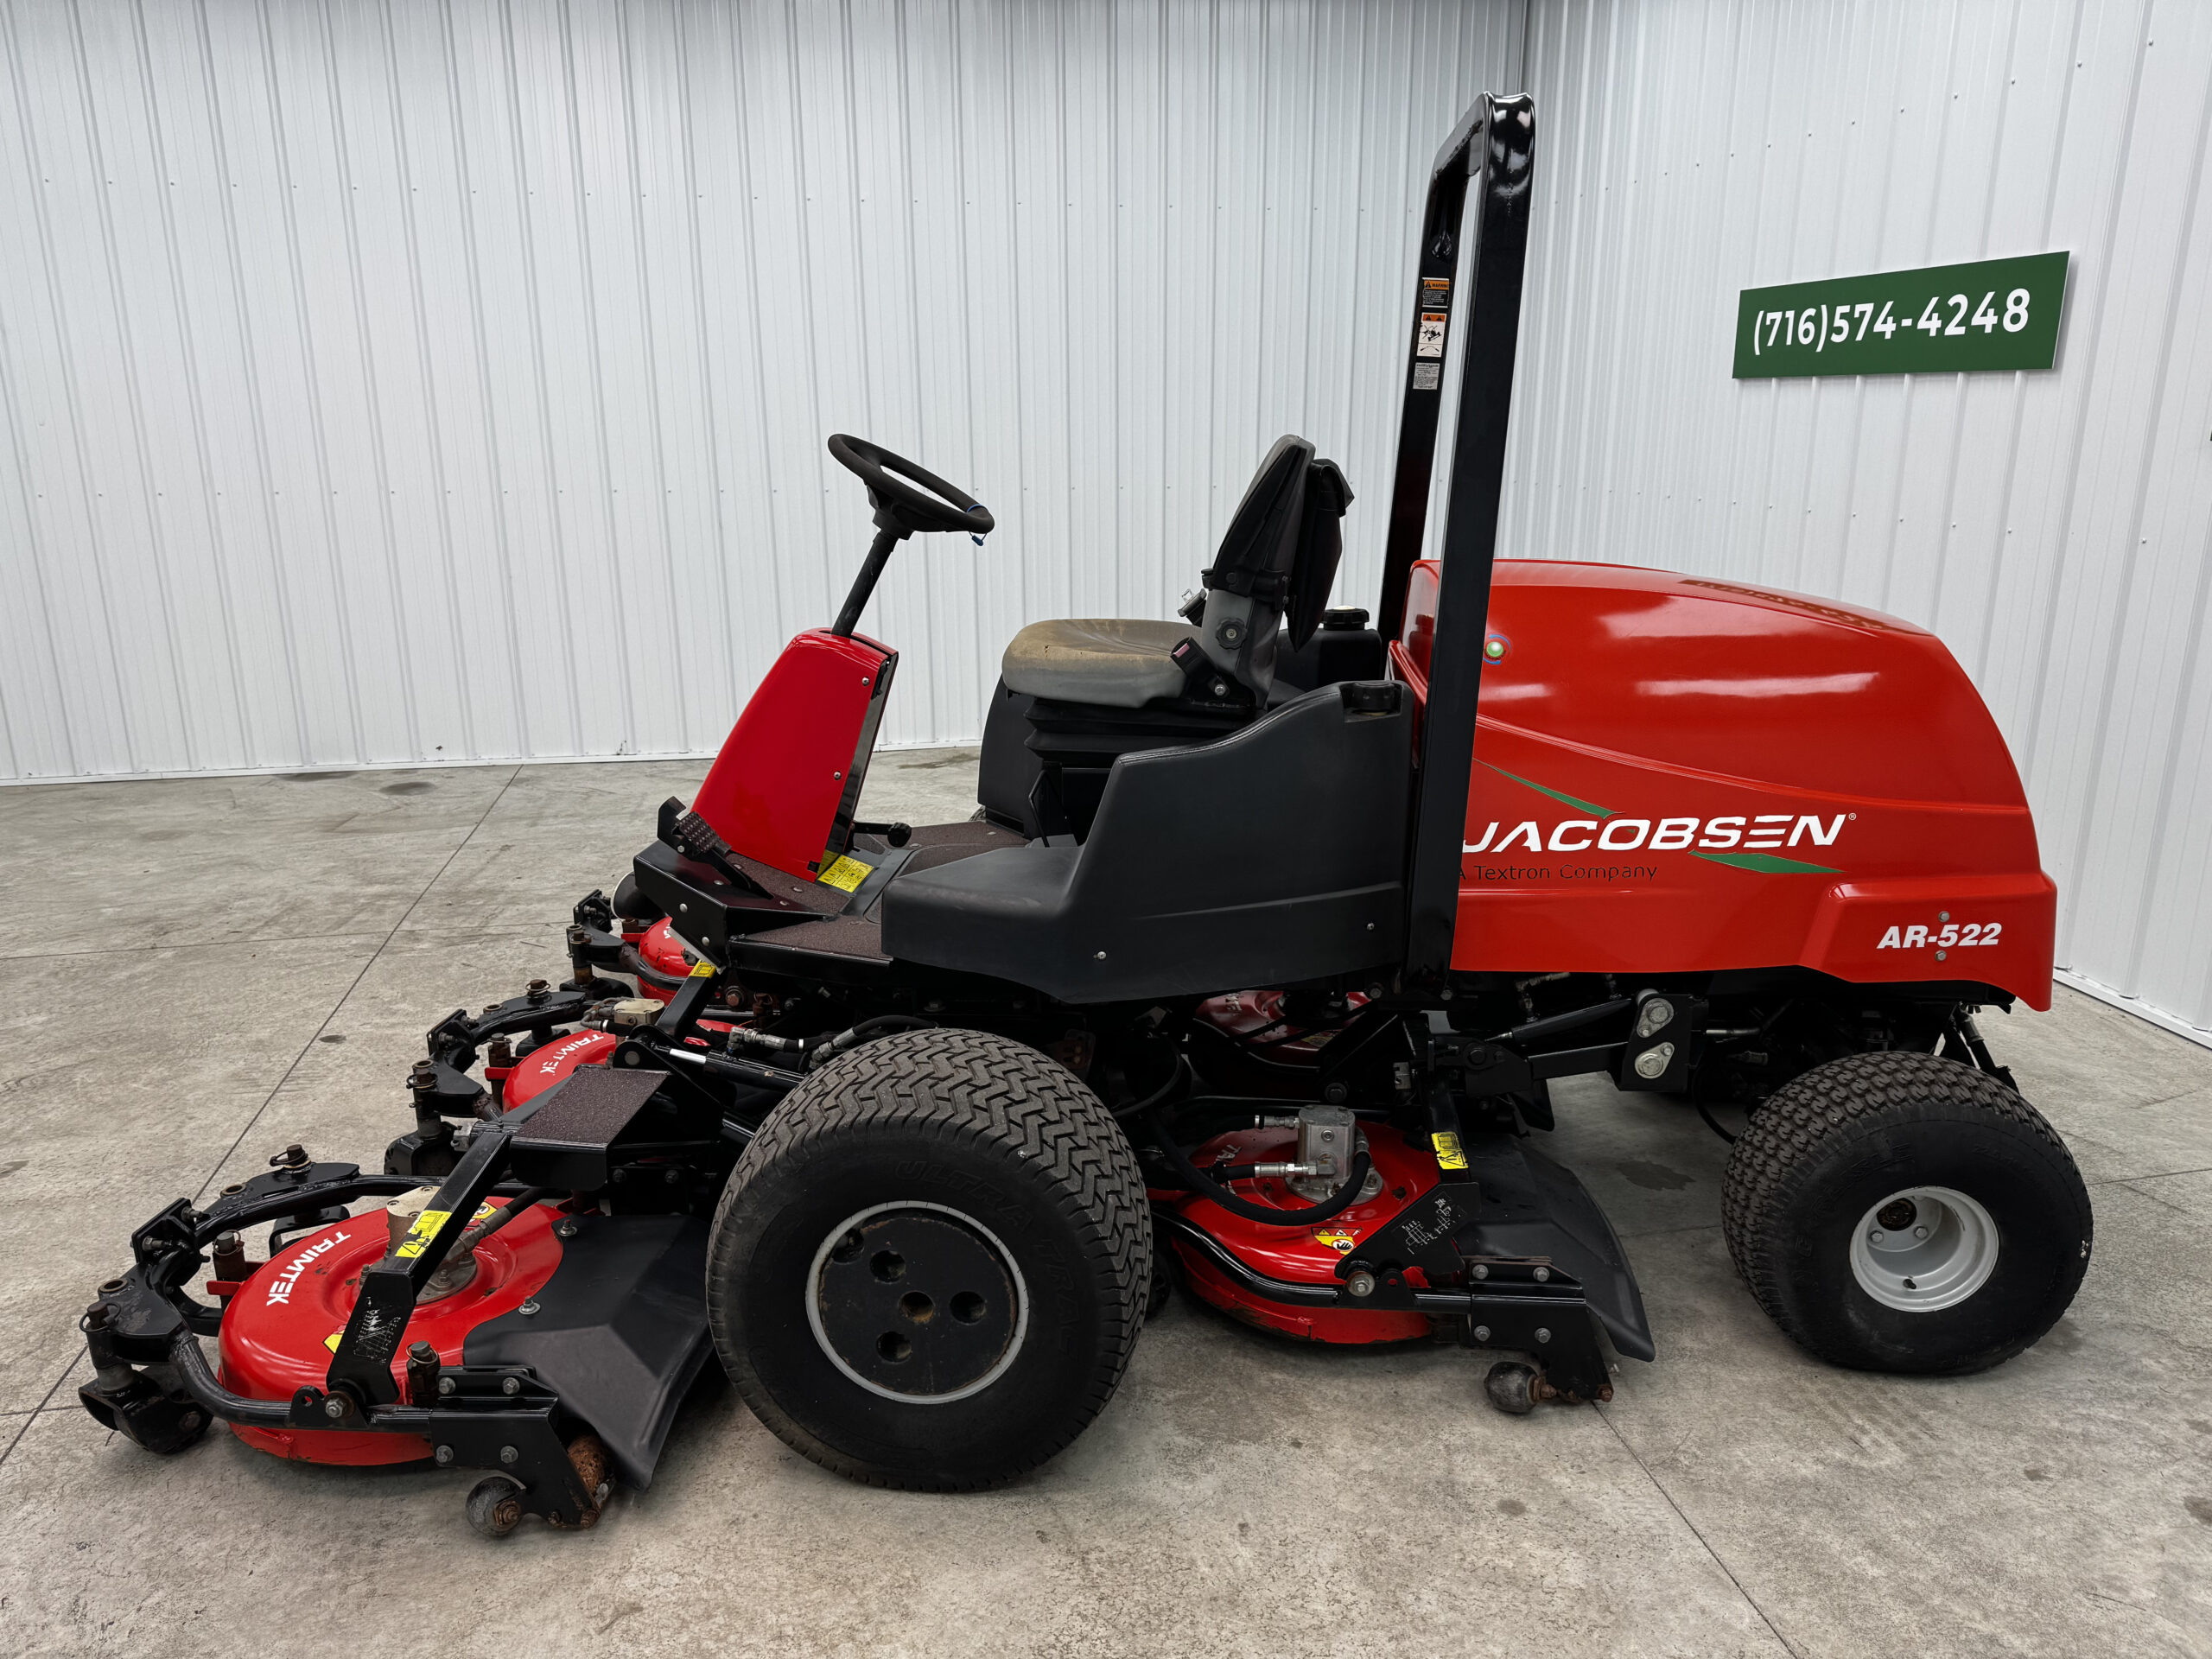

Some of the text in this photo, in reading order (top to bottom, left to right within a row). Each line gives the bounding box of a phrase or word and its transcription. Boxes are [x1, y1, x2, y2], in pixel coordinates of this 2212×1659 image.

[1753, 287, 2031, 356] (716)574-4248
[1462, 814, 1847, 854] JACOBSEN
[1473, 865, 1550, 880] Textron
[1560, 864, 1658, 882] Company
[1876, 922, 2002, 950] AR-522
[539, 1033, 605, 1074] TRIMTEK
[893, 1160, 1034, 1233] ULTRA
[266, 1231, 353, 1306] TRIMTEK
